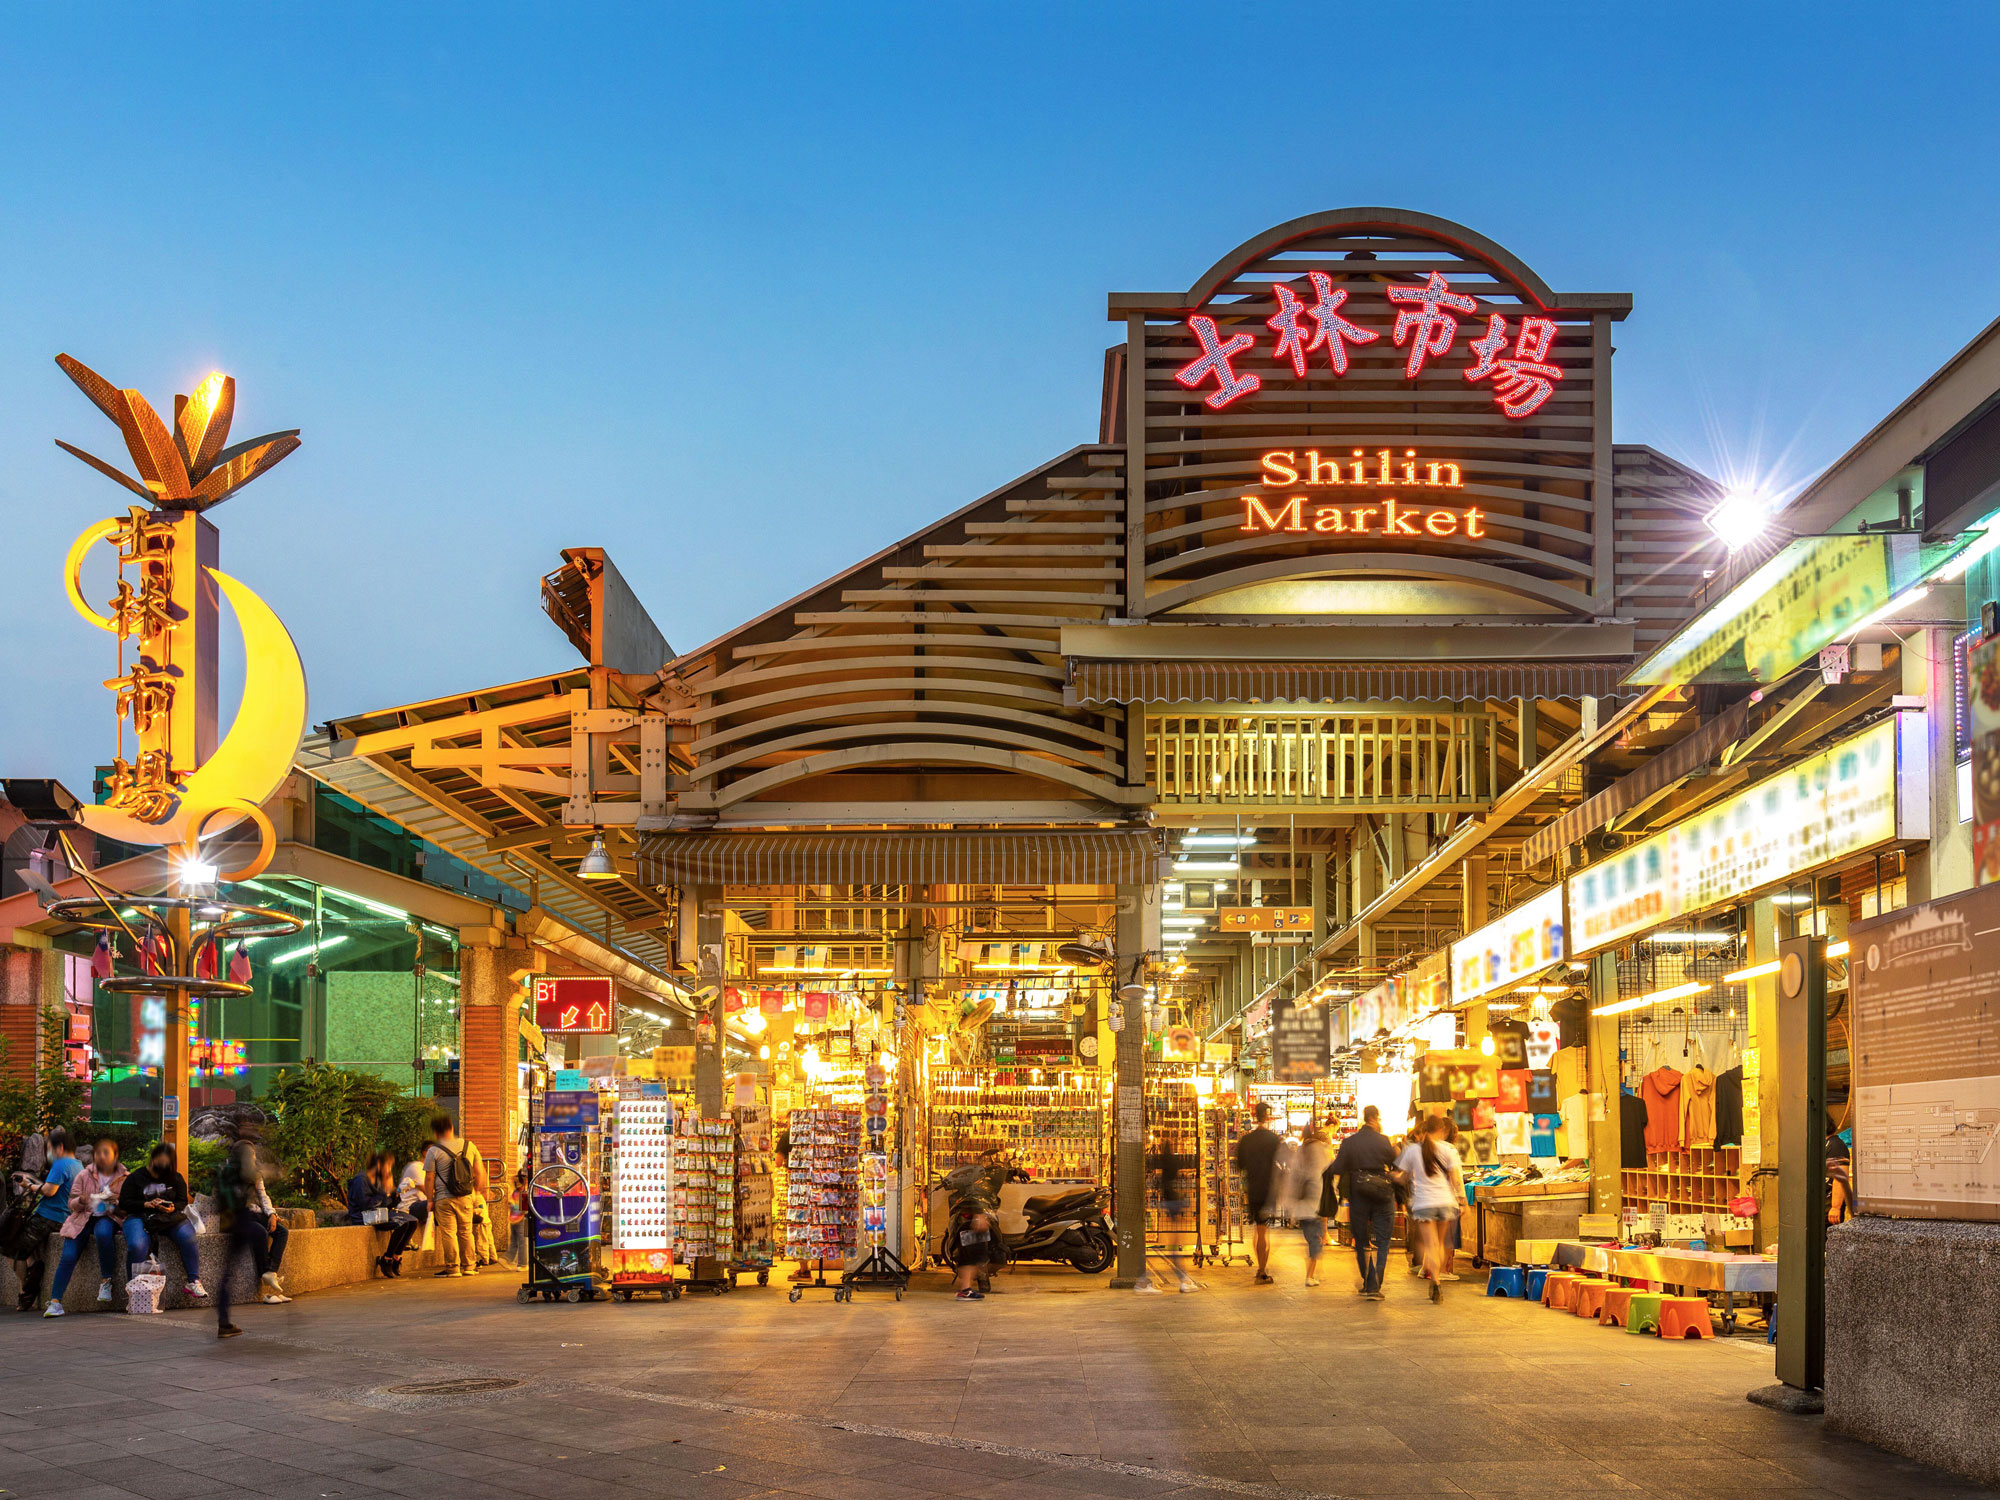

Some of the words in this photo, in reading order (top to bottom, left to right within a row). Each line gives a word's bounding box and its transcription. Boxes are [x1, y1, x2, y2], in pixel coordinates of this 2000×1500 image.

[1174, 270, 1563, 418] 士林市場
[1260, 449, 1465, 488] Shilin
[1240, 496, 1486, 539] Market
[102, 505, 181, 824] 士林市場
[537, 982, 556, 1002] B1
